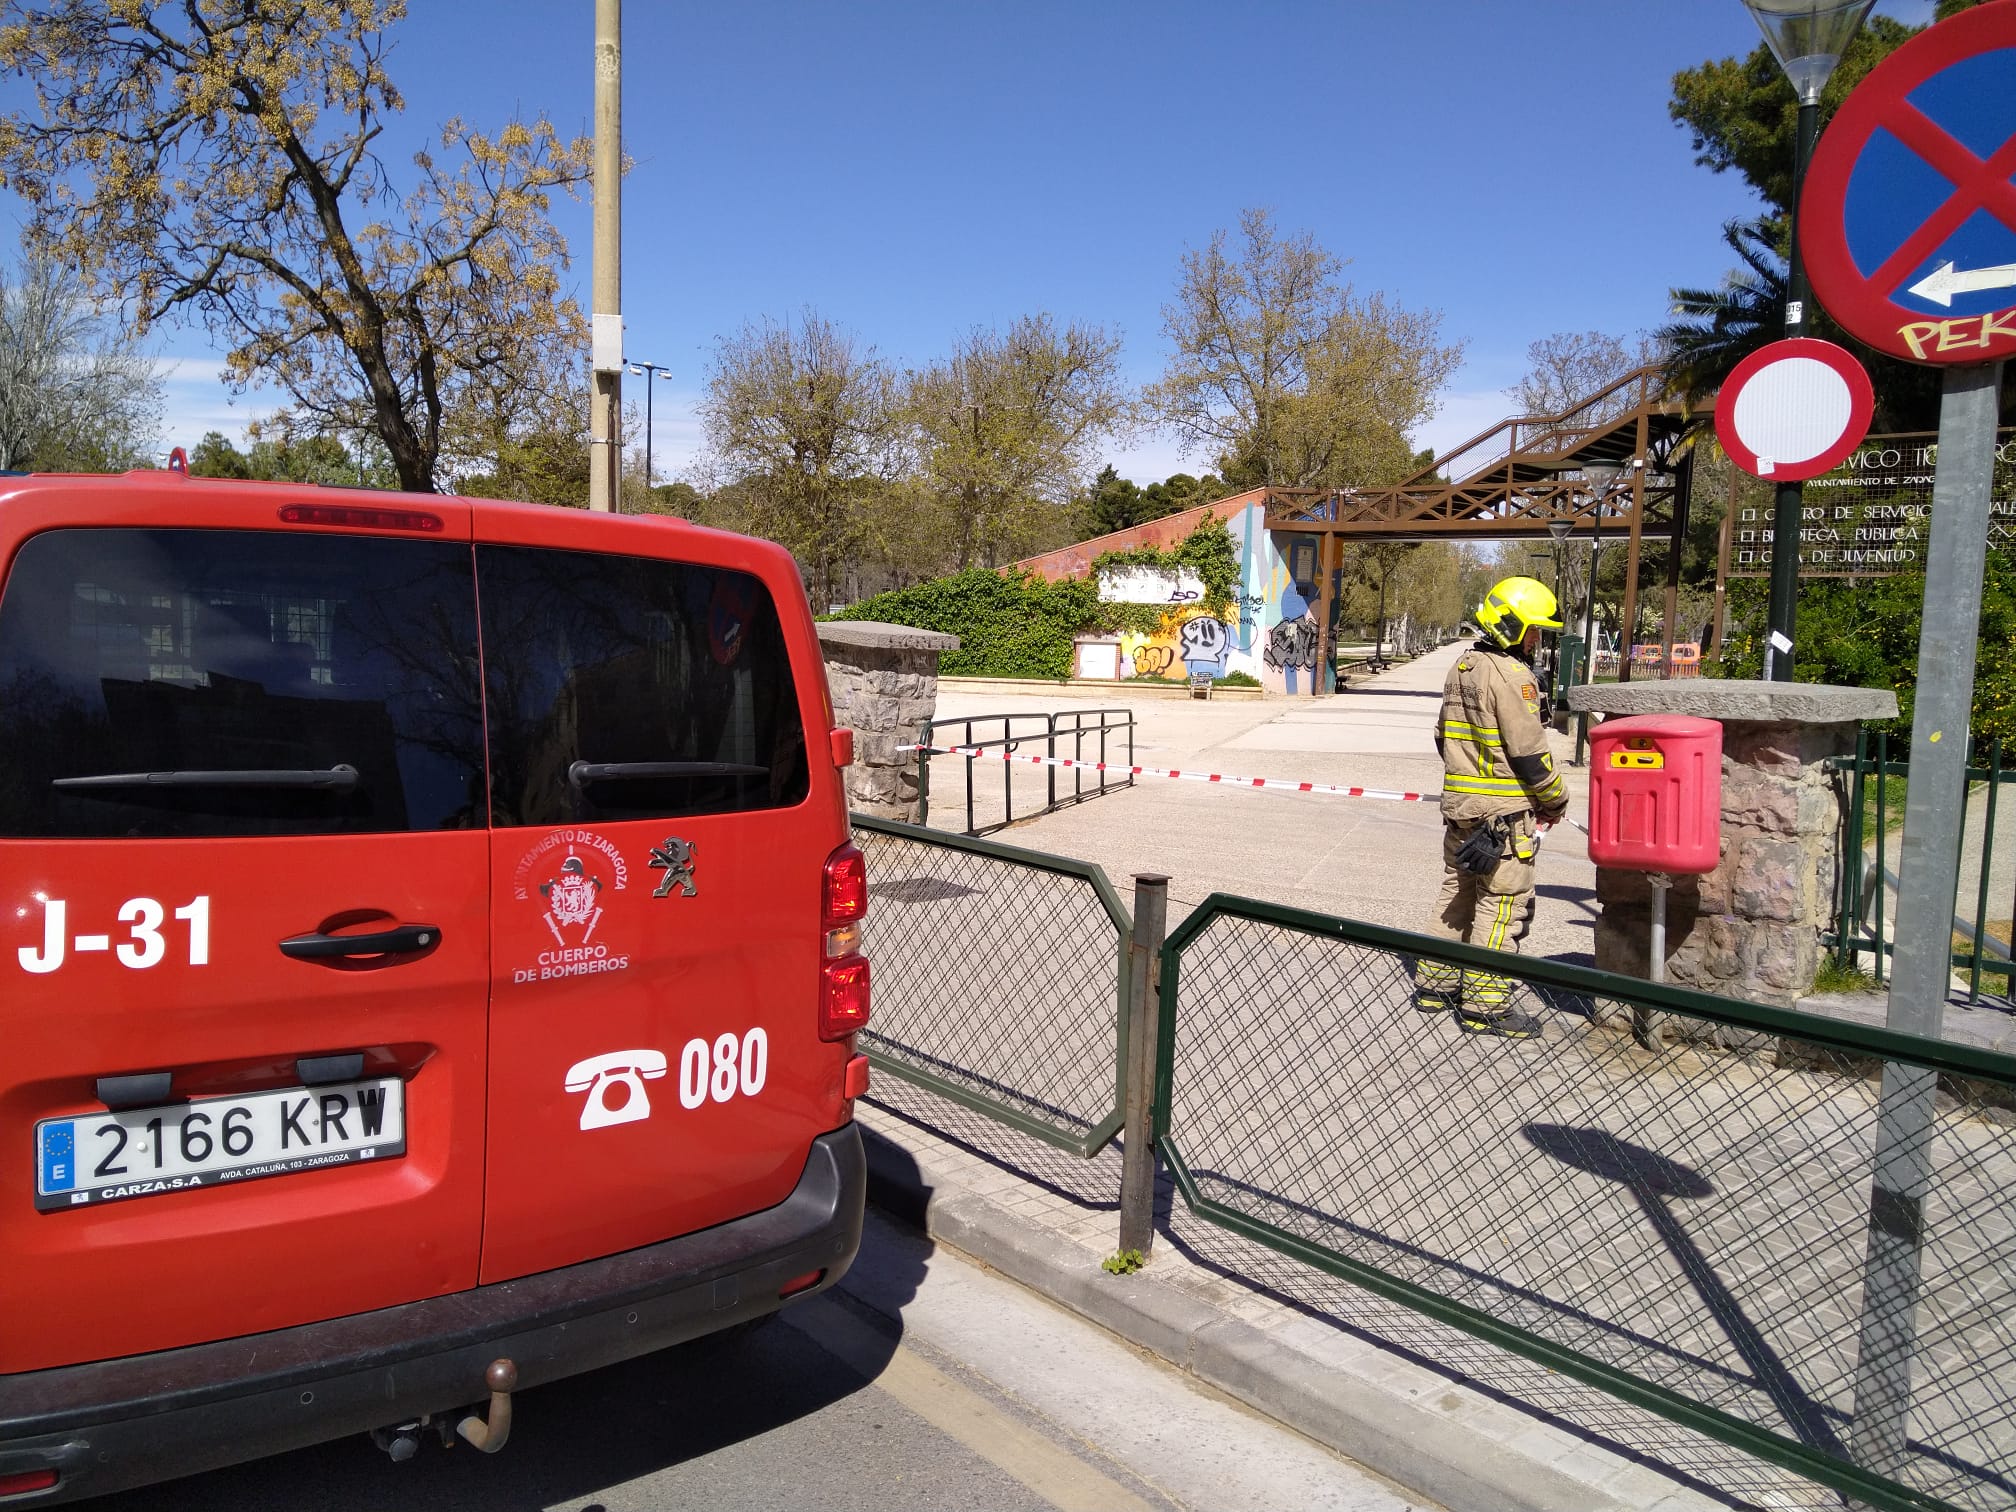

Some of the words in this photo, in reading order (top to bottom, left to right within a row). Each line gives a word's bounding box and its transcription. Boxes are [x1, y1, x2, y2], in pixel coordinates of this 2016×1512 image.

[1833, 449, 1901, 469] VICO
[1806, 478, 1881, 488] AYUNTAMIENTO
[1884, 476, 1899, 485] DE
[1835, 506, 1854, 519] DE
[1855, 527, 1918, 541] PUBLICA
[1812, 549, 1834, 563] DE
[1838, 549, 1915, 563] JUVENTUD
[514, 830, 574, 901] AYUNTAMIENTO
[576, 830, 593, 845] DE
[592, 834, 628, 891] ZARAGOZA
[17, 895, 210, 974] J-31
[538, 945, 608, 966] CUERPO
[514, 970, 537, 984] DE
[541, 956, 629, 980] BOMBEROS
[679, 1027, 768, 1110] 080
[94, 1106, 254, 1178] 2166
[280, 1087, 387, 1150] KRW
[52, 1164, 66, 1180] E
[220, 1169, 244, 1180] AVDA.
[290, 1160, 303, 1170] 103
[308, 1153, 350, 1166] ZARAGOZA
